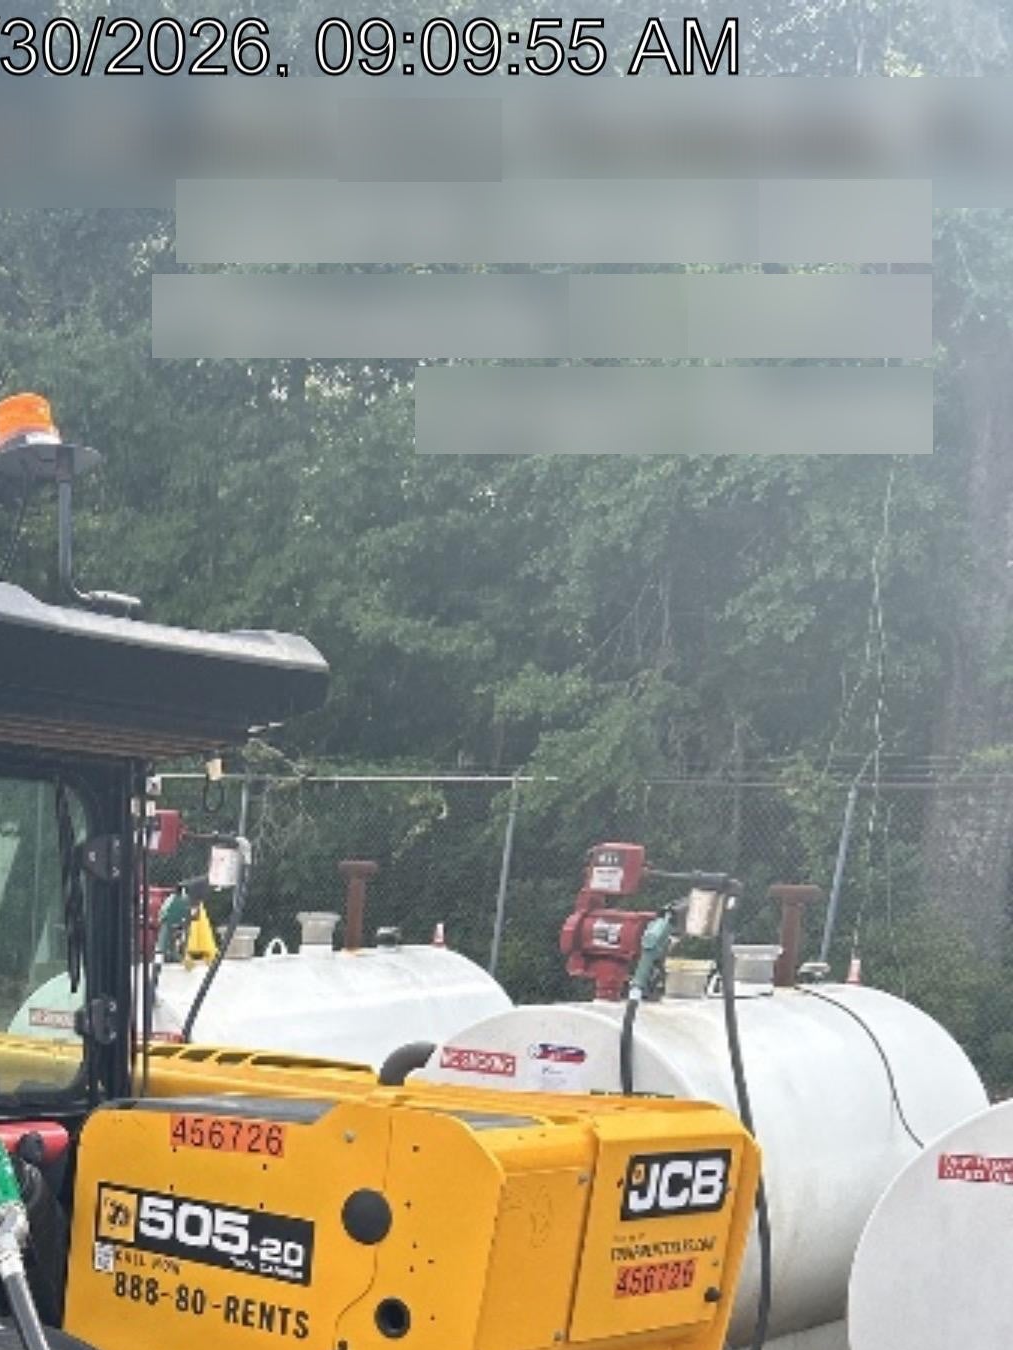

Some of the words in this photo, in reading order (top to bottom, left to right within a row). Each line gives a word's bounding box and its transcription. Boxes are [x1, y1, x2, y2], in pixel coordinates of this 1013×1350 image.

[173, 1117, 284, 1155] 456726
[628, 1158, 726, 1212] JCB
[616, 1259, 694, 1297] 456726
[115, 1271, 310, 1339] 888-80-RENTS
